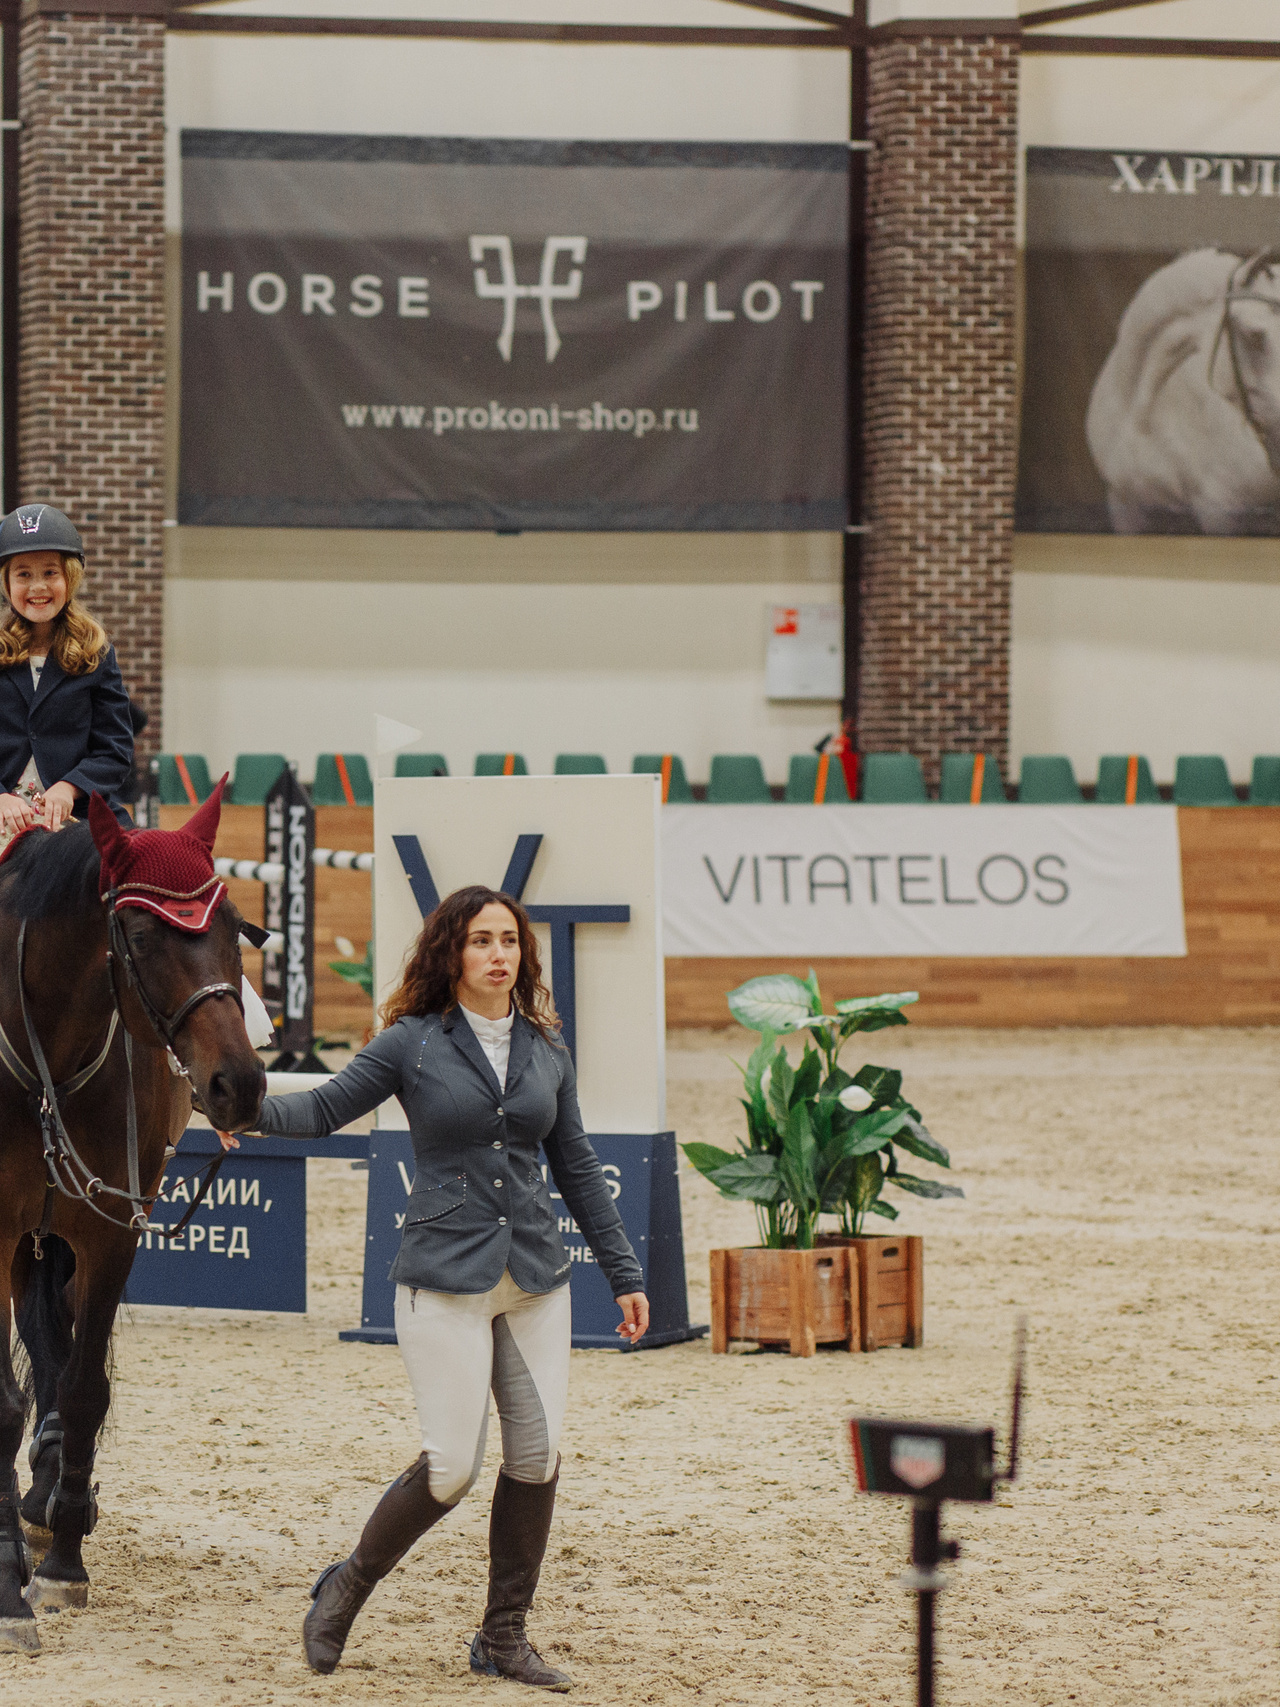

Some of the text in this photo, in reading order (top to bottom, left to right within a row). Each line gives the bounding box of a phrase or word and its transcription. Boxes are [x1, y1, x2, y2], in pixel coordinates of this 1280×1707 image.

[1109, 155, 1280, 196] ХАРТЛ
[197, 271, 824, 322] HORSE PILOT
[341, 401, 699, 437] www.prokoni-shop.ru
[702, 854, 1070, 905] VITATELOS
[286, 805, 307, 1020] ESKADRON
[137, 1222, 251, 1260] ПЕРЕД
